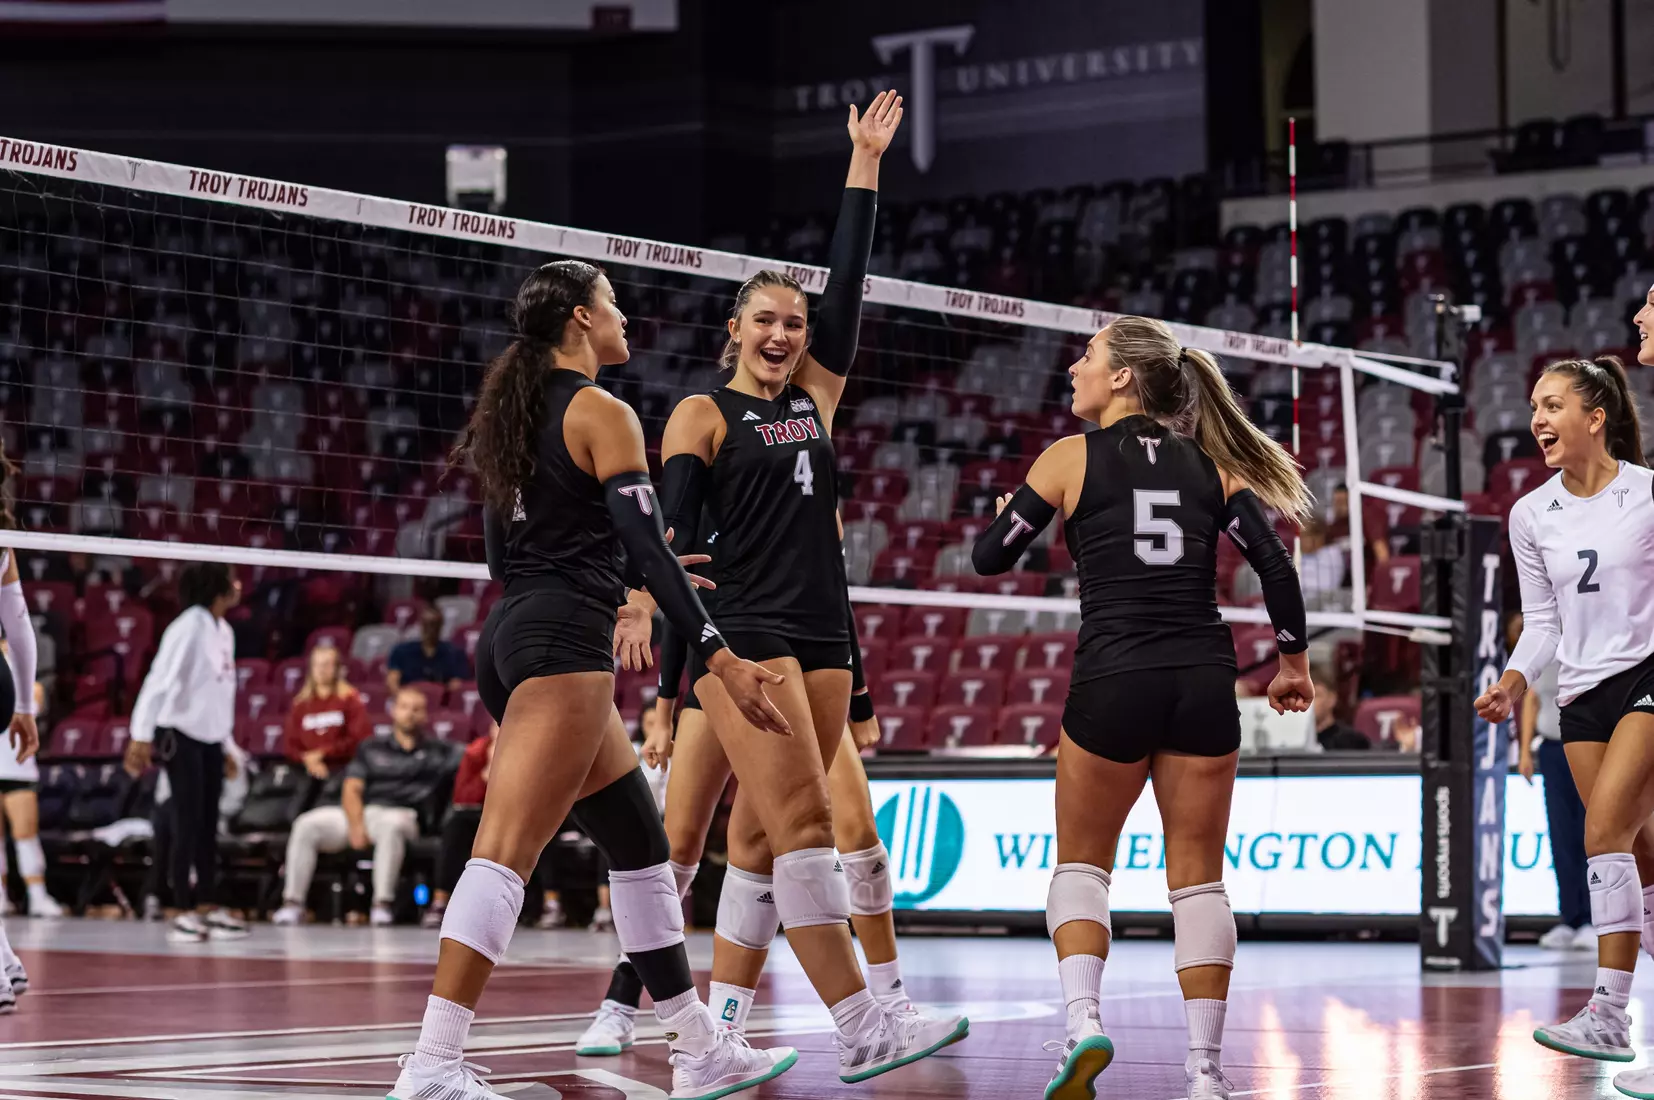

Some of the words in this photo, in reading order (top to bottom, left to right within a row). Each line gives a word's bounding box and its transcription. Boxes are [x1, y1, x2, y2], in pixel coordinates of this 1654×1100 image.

[956, 37, 1203, 92] UNIVERSITY
[0, 139, 78, 171] TROJANS
[189, 169, 233, 195] TROY
[238, 177, 308, 206] TROJANS
[408, 205, 447, 228] TROY
[452, 212, 516, 239] TROJANS
[605, 237, 641, 257] TROY
[645, 243, 703, 269] TROJANS
[945, 290, 973, 310] TROY
[977, 295, 1025, 318] TROJANS
[754, 416, 820, 446] TROY
[793, 449, 814, 496] 4
[1133, 488, 1185, 566] 5
[1577, 549, 1600, 594] 2
[993, 832, 1399, 871] WIENGTON
